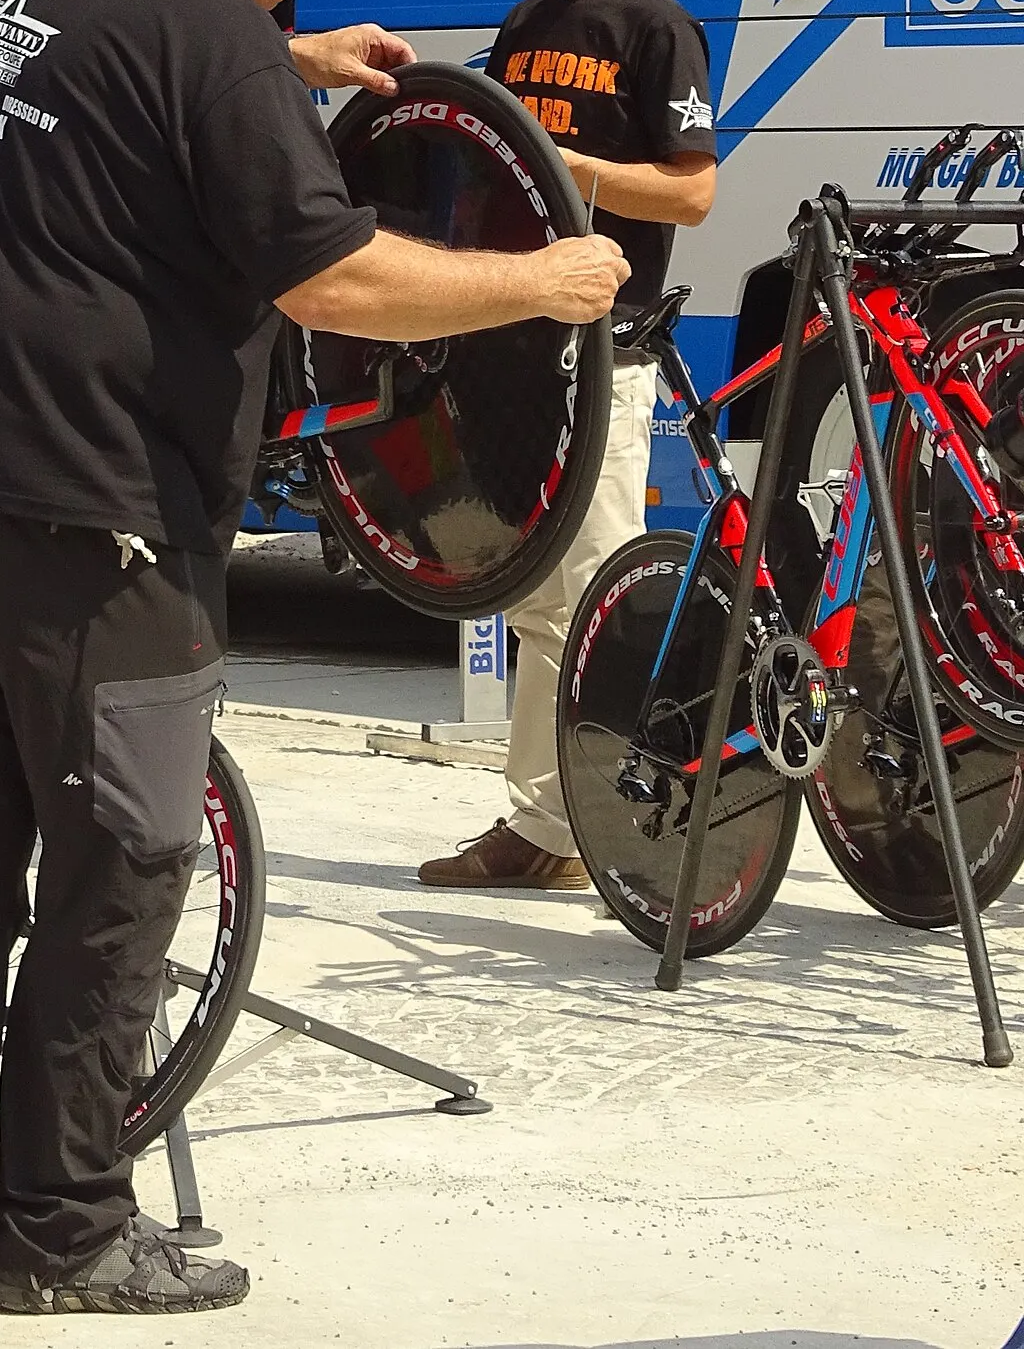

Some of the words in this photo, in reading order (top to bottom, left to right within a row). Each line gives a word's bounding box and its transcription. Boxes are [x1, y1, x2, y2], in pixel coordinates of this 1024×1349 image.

[530, 50, 620, 95] WORK
[39, 112, 59, 133] BY
[371, 103, 449, 140] DISC
[455, 113, 549, 218] SPEED
[604, 561, 675, 608] SPEED
[571, 608, 601, 703] DISC
[816, 782, 863, 862] DISC
[607, 867, 742, 925] FULRUM
